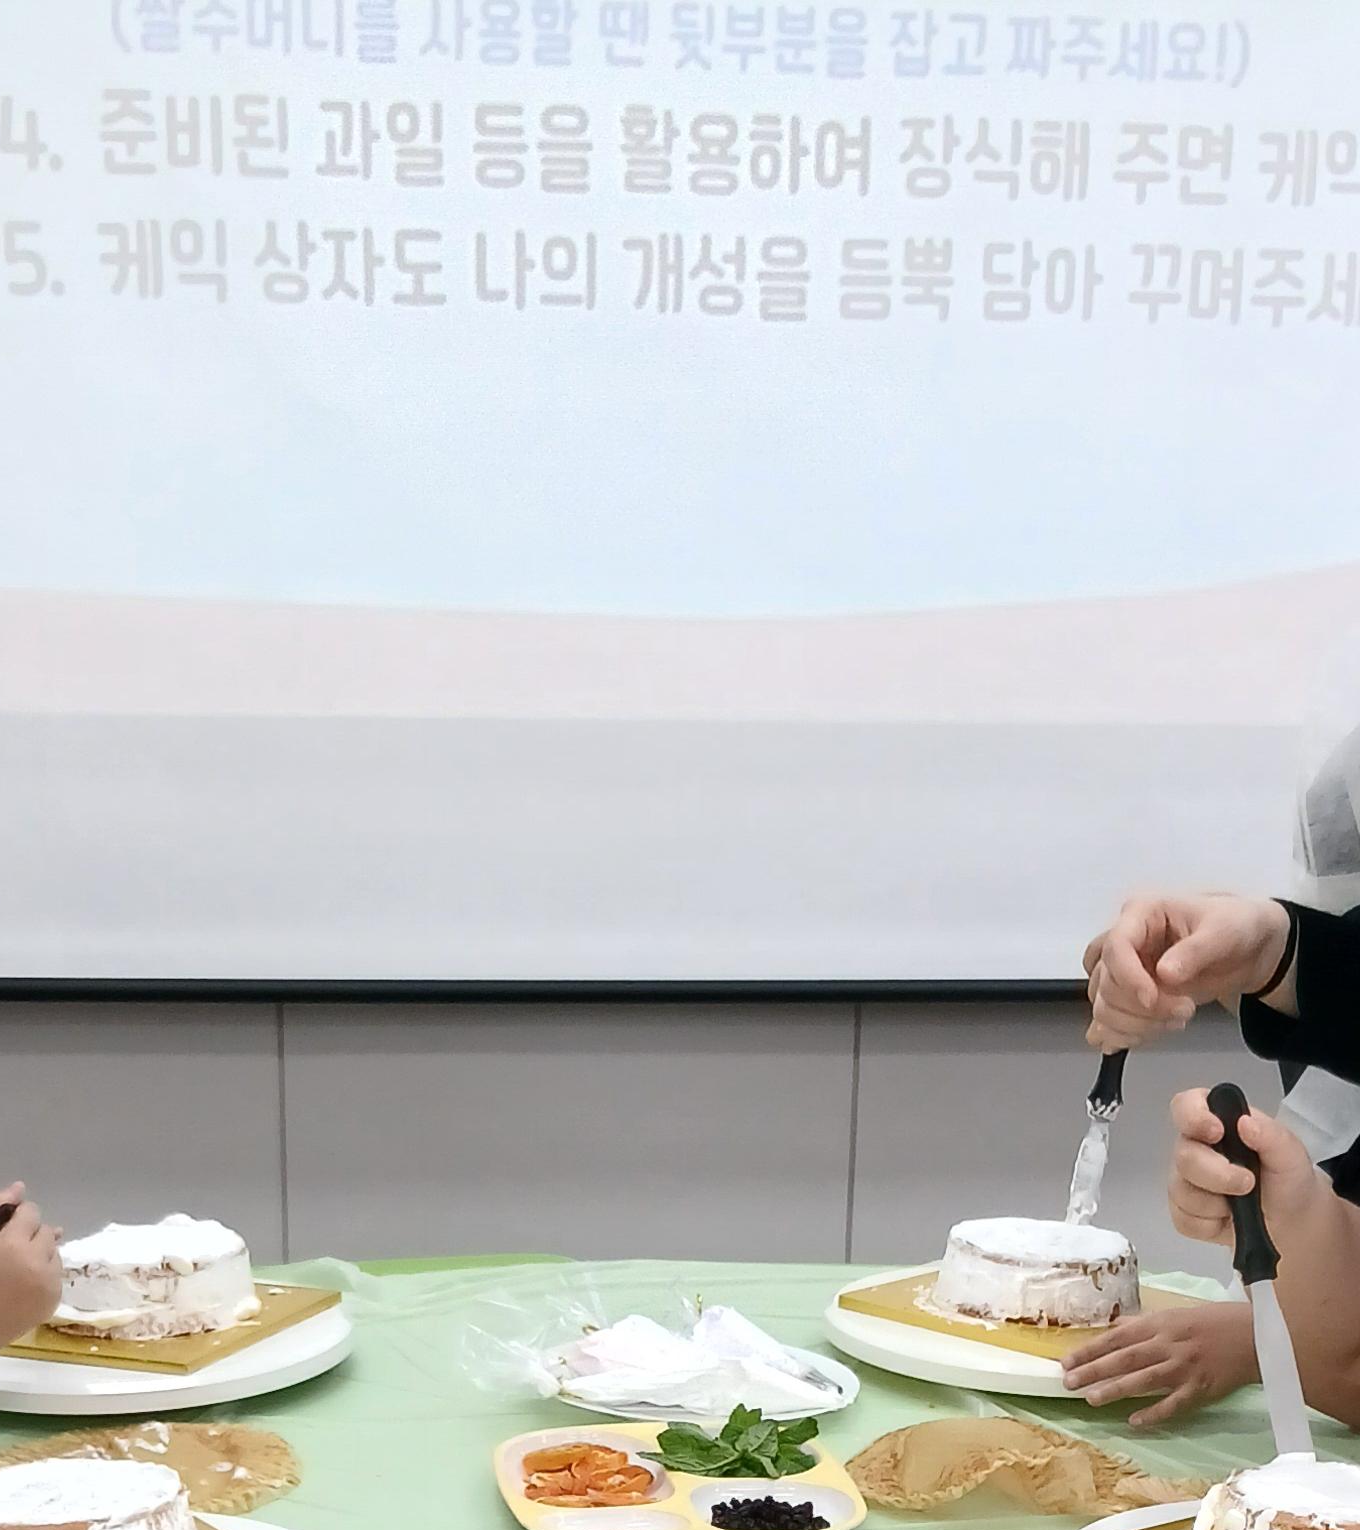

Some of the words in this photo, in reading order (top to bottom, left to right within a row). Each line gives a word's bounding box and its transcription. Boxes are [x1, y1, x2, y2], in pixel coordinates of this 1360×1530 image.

[420, 0, 578, 67] 사용할
[600, 0, 652, 67] 땐
[670, 4, 869, 79] 뒷부분을
[890, 11, 988, 77] 잡고
[1008, 15, 1251, 88] 짜주세요!)
[100, 88, 291, 178] 준비된
[316, 100, 445, 186] 과일
[472, 104, 593, 193] 등을
[620, 104, 873, 197] 활용하여
[898, 116, 1091, 201] 장식해
[1112, 123, 1234, 205] 주면
[2, 220, 66, 297] 5.
[96, 218, 230, 304] 케익
[254, 220, 447, 306] 상자도
[474, 228, 598, 310] 나의
[622, 232, 812, 322] 개성을
[839, 238, 954, 322] 듬뿍
[982, 241, 1103, 323] 담아
